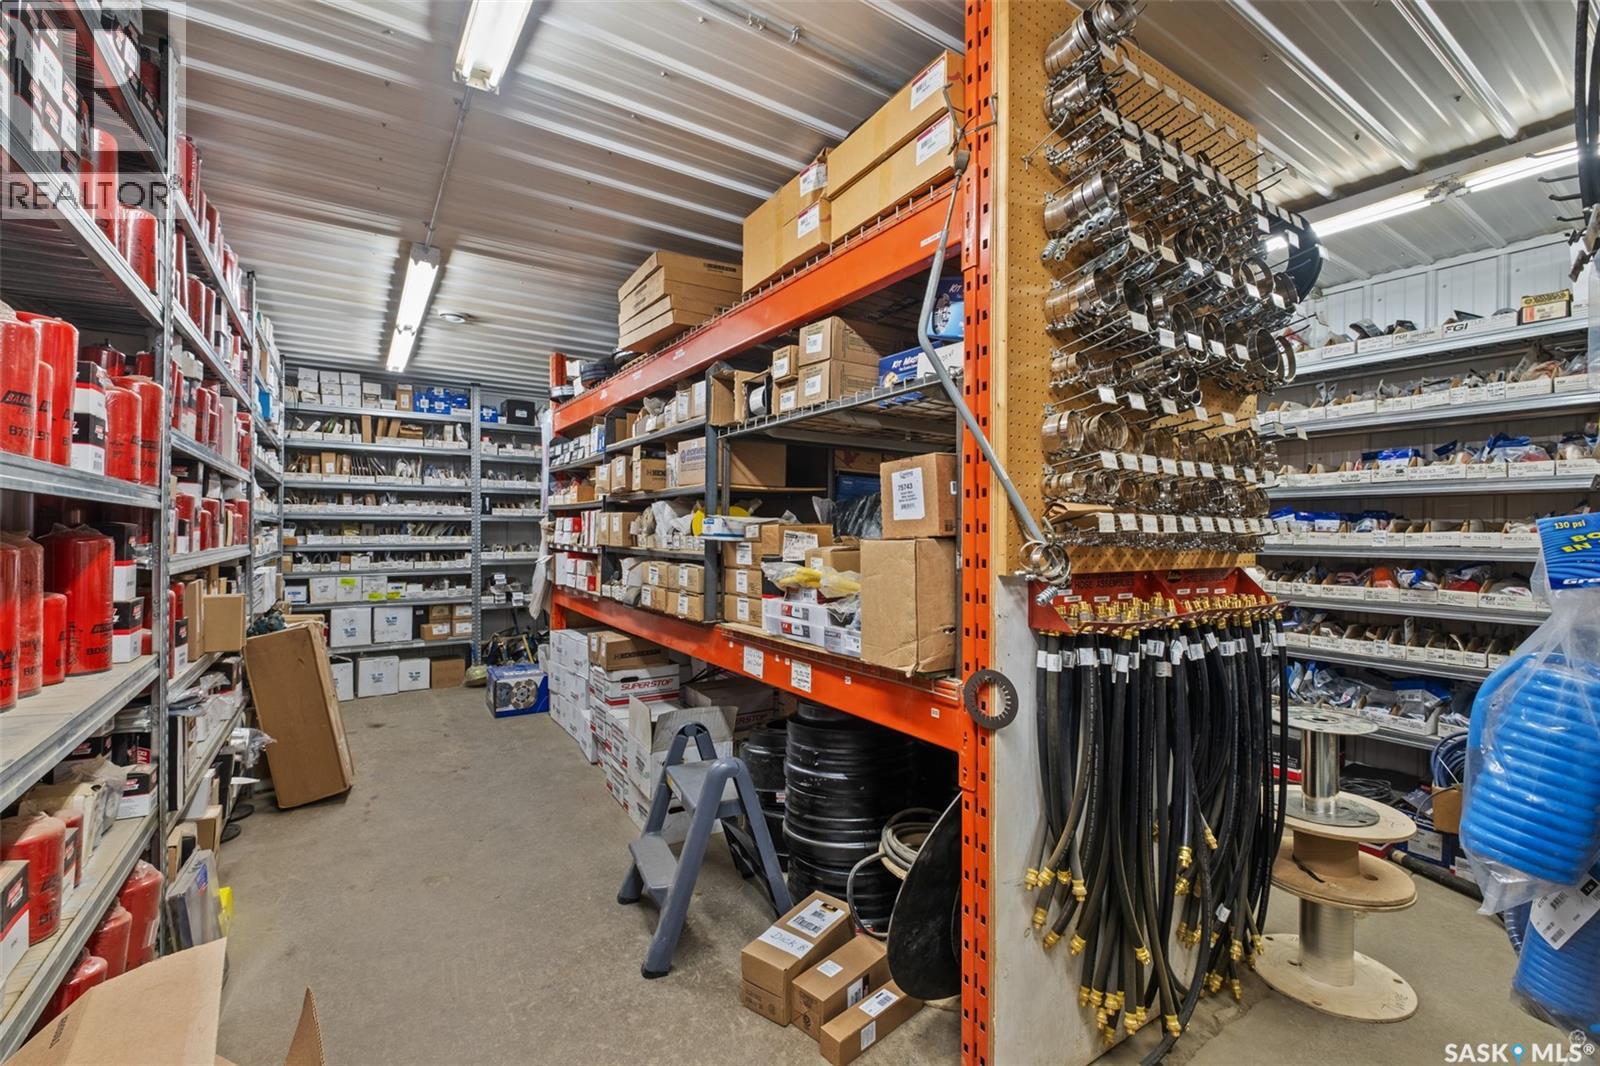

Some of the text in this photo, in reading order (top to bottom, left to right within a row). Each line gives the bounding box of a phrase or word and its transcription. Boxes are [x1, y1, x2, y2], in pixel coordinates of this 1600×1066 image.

[897, 483, 913, 492] 75743
[1554, 519, 1586, 529] 130 psi
[1561, 542, 1592, 553] EN
